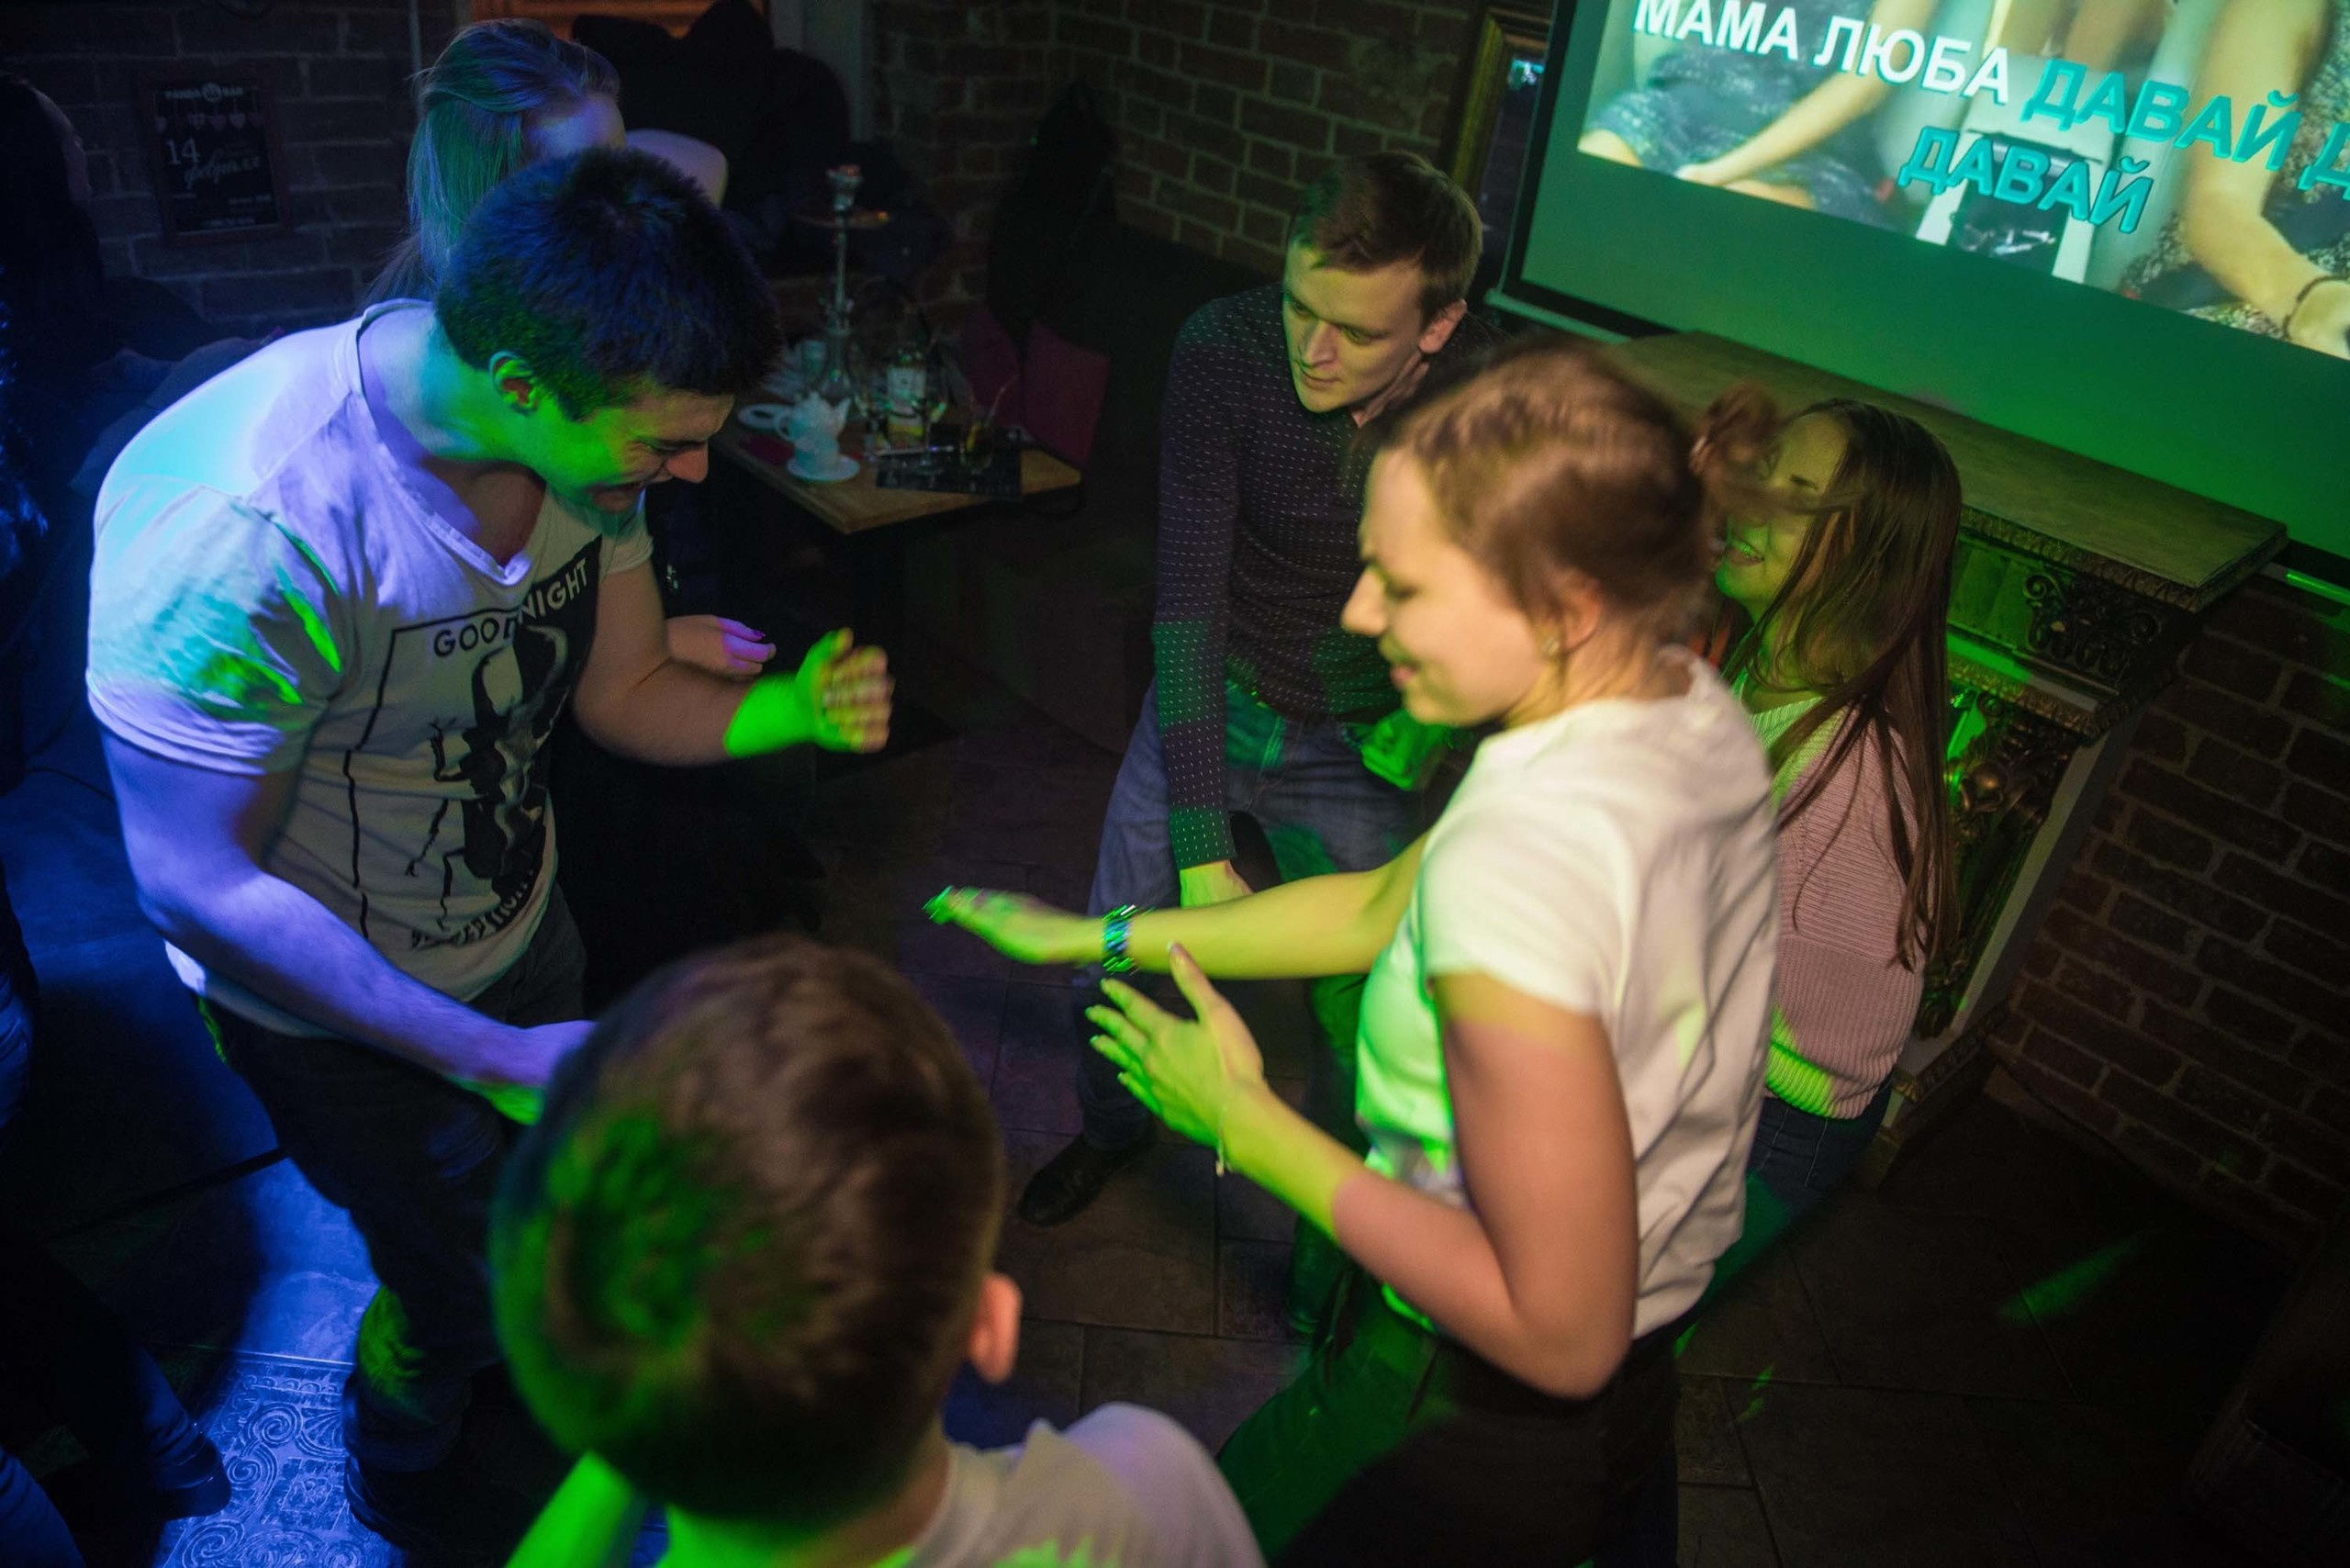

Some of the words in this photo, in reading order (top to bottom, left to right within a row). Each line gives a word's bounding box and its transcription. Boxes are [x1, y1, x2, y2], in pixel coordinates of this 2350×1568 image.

[1632, 0, 1800, 62] МАМА
[1812, 14, 2011, 106] ЛЮБА
[2021, 58, 2304, 173] ДАВАЙ
[165, 137, 202, 166] 14
[1897, 126, 2154, 235] ДАВАЙ
[518, 556, 589, 625] NIGHT
